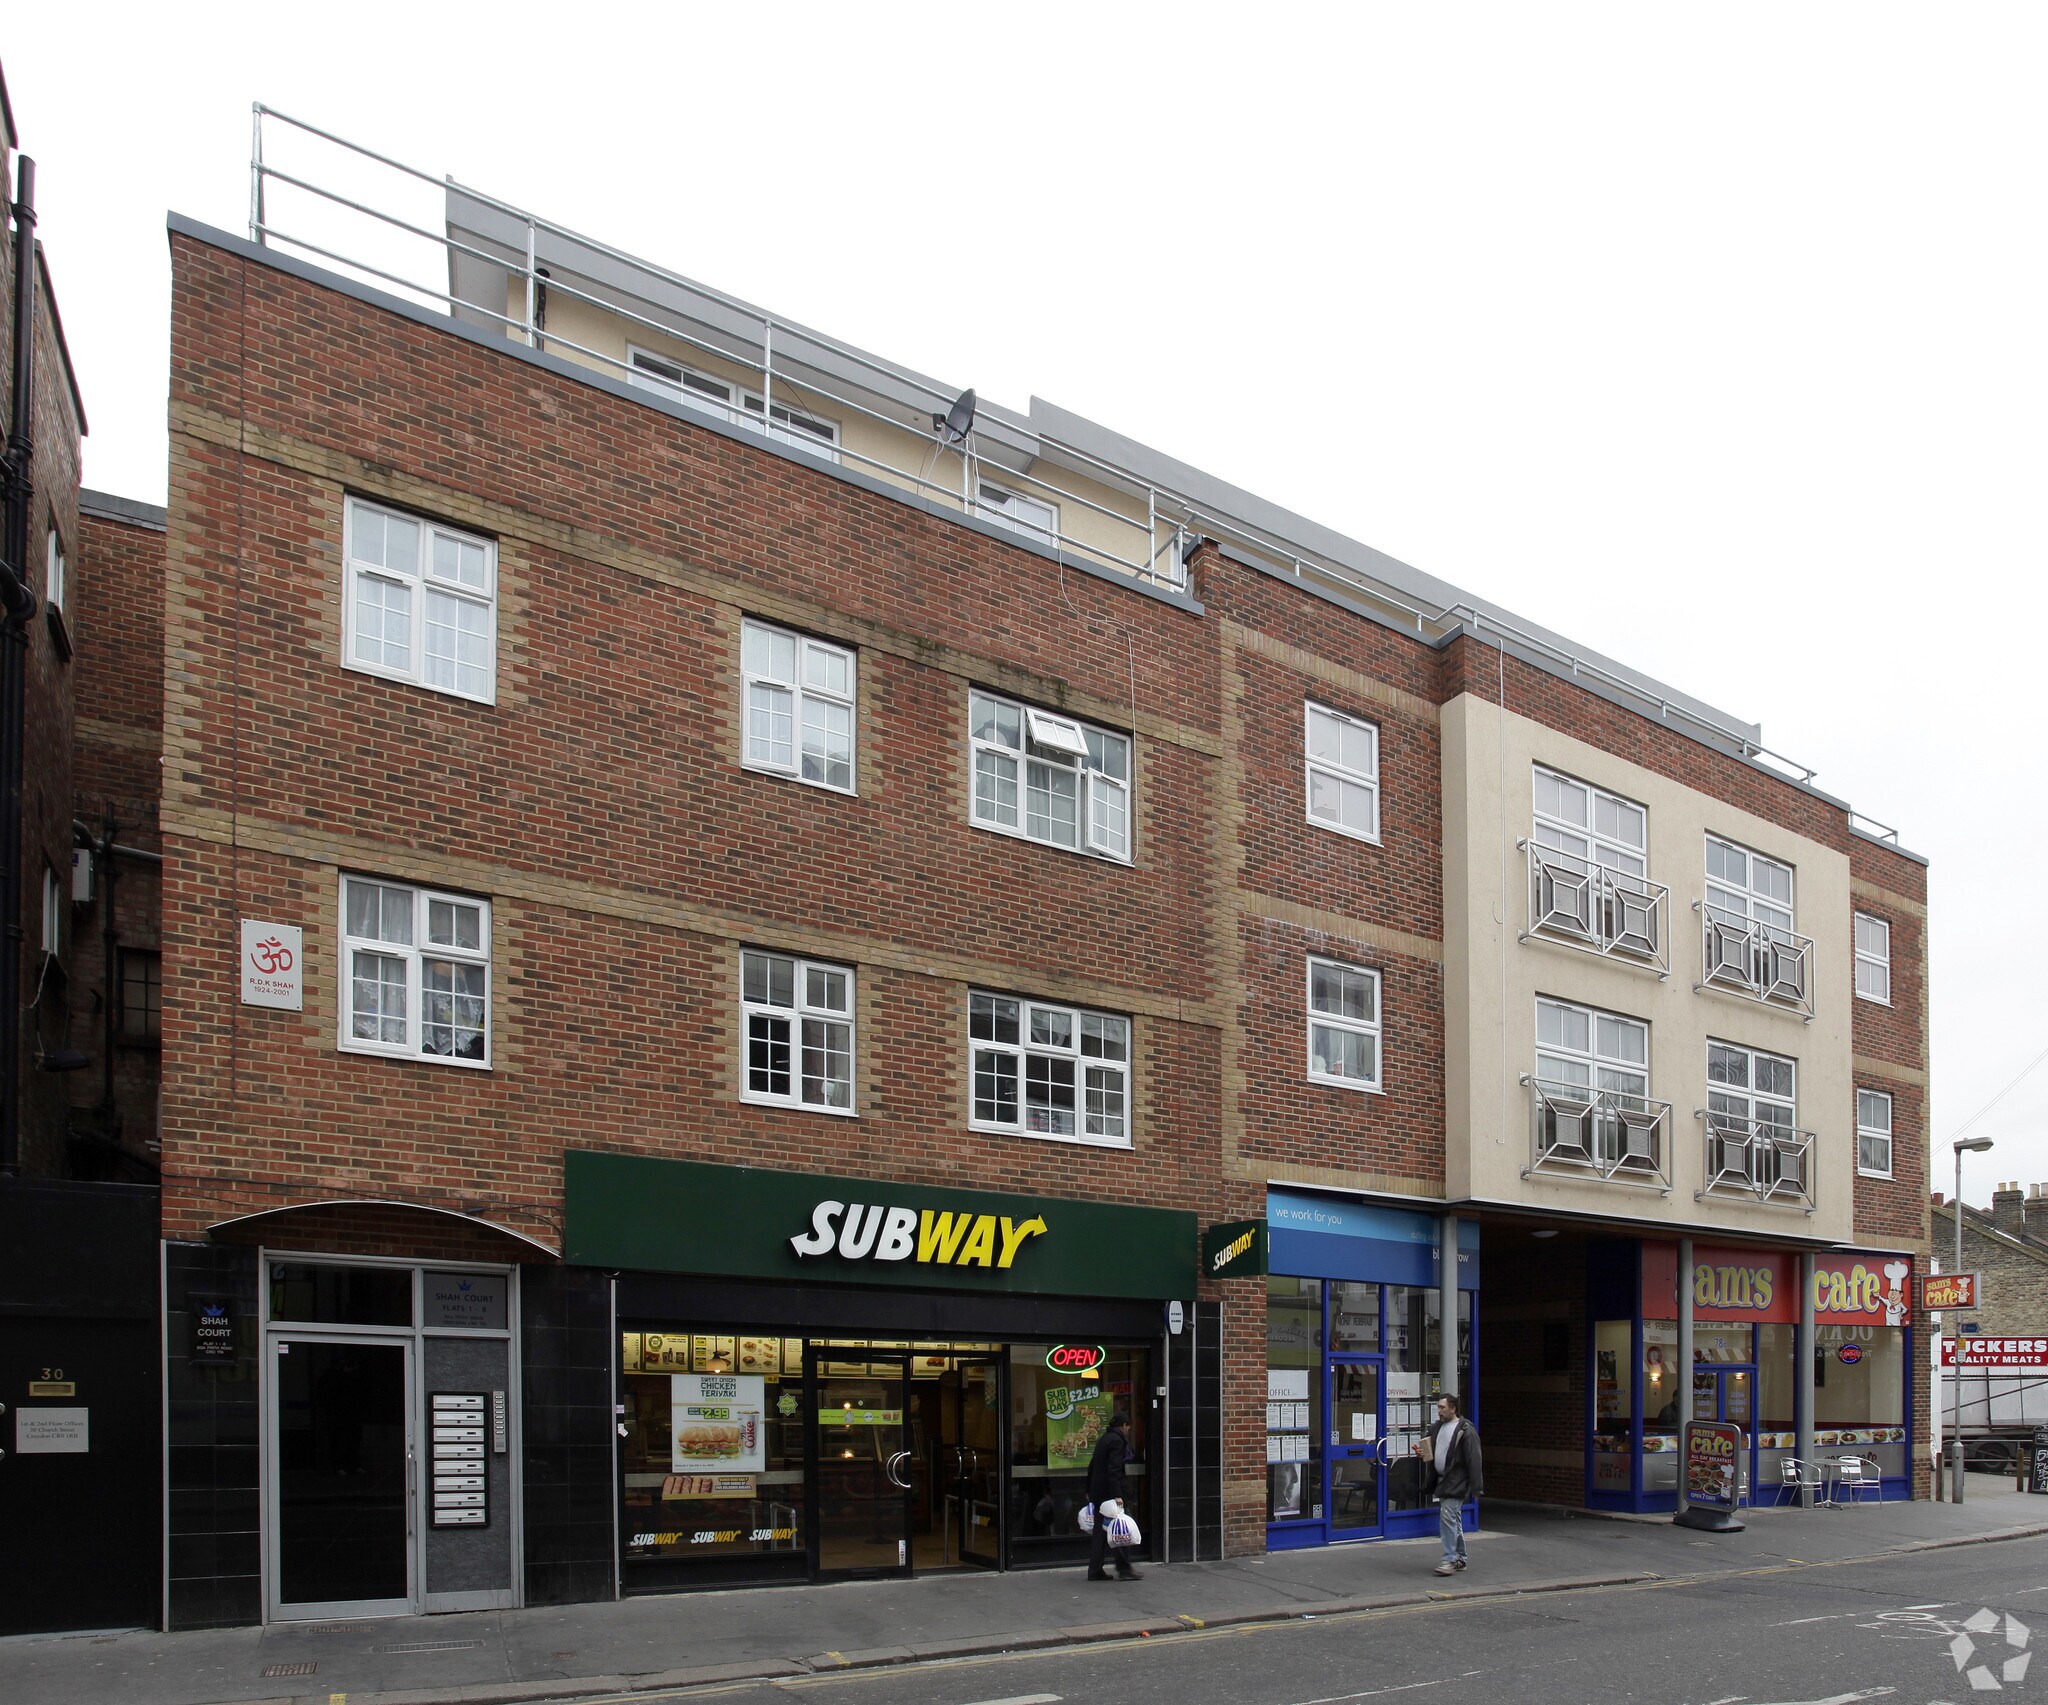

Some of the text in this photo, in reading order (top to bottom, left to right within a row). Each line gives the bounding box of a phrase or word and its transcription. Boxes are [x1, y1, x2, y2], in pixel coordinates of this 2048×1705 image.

[254, 986, 290, 996] 1924-2001
[272, 981, 294, 990] SHAH
[1275, 1208, 1342, 1226] we work for you
[790, 1200, 1048, 1268] SUBWAY
[1213, 1228, 1255, 1271] SUBWAY
[1675, 1264, 1881, 1314] am's cafe
[435, 1293, 494, 1303] SHAH COURT
[1925, 1288, 1958, 1307] cafe
[201, 1317, 228, 1325] SHAH
[197, 1328, 231, 1337] COURT
[1053, 1349, 1097, 1366] OPEN
[1948, 1355, 2042, 1364] QALITY MEATS
[41, 1367, 64, 1380] 30
[701, 1382, 736, 1390] CHICKEN
[1269, 1388, 1291, 1397] OFFICE
[1387, 1388, 1408, 1396] DRIVING
[1047, 1389, 1066, 1399] SUB
[1070, 1386, 1099, 1402] £2.29
[1049, 1400, 1068, 1411] DAY
[700, 1408, 729, 1419] £2.99
[745, 1421, 754, 1448] Coke
[1690, 1436, 1734, 1458] cafe
[630, 1532, 683, 1546] SUBWAY
[690, 1529, 741, 1544] SUBWAY
[749, 1527, 798, 1541] SUBWAY
